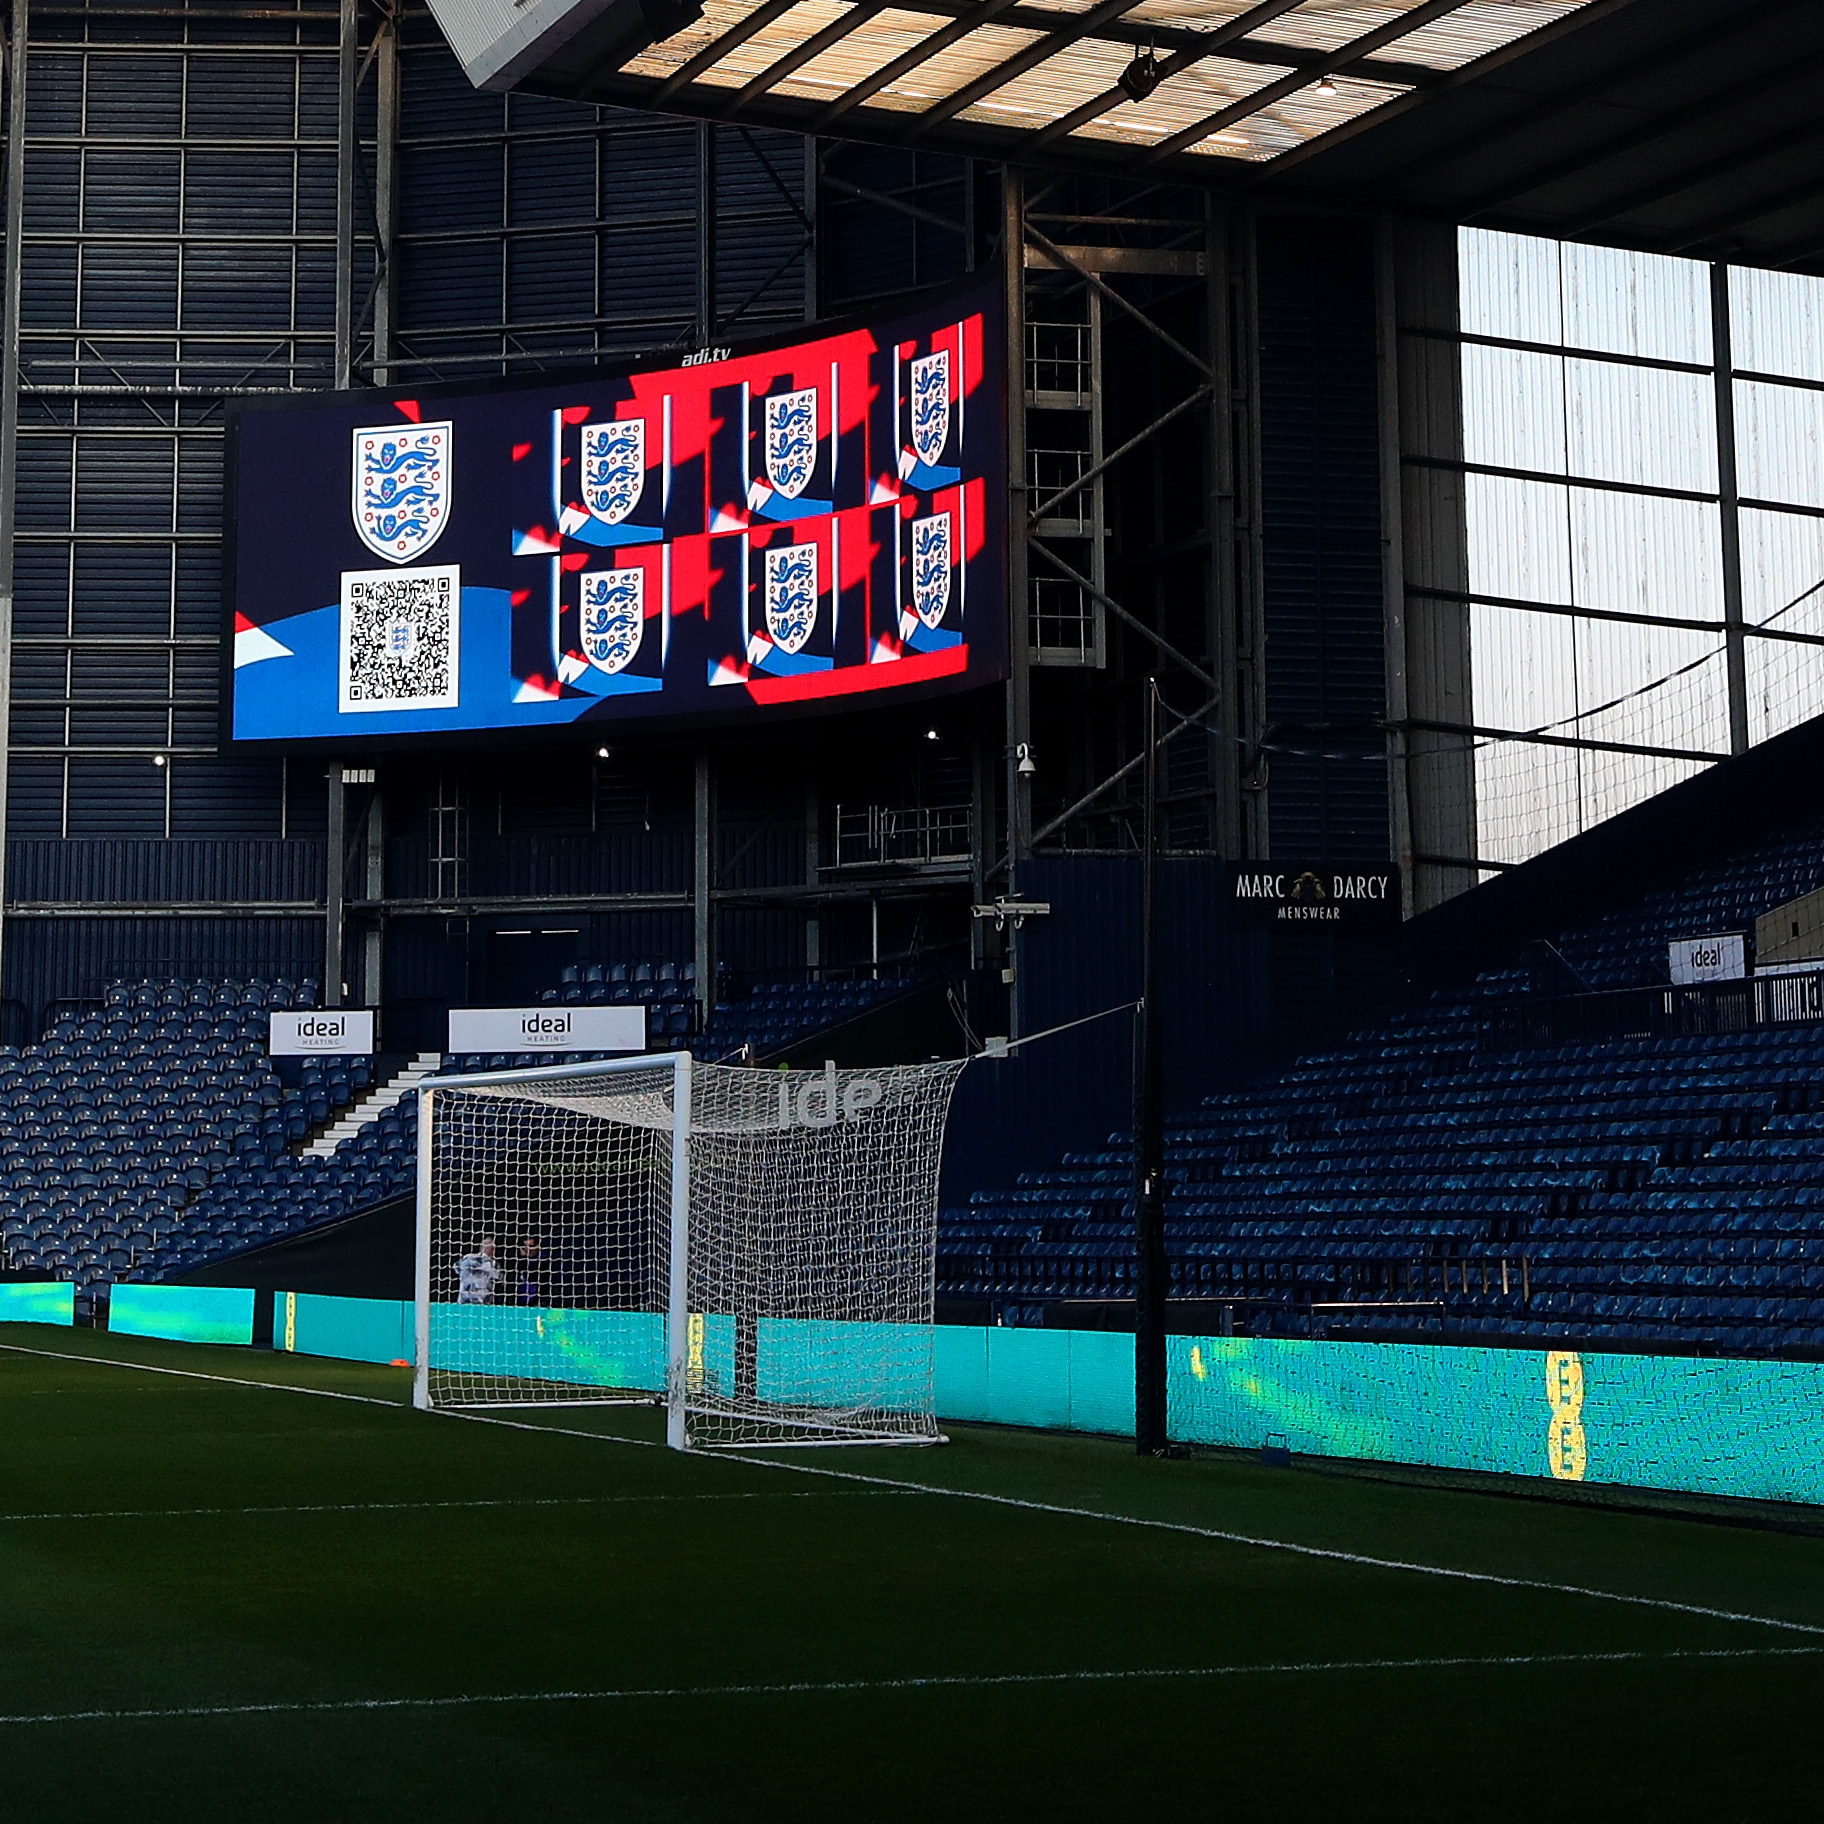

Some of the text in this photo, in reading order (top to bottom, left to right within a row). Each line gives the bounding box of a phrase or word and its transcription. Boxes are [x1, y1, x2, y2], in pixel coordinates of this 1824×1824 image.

[681, 347, 731, 367] adi.tv
[1236, 875, 1389, 899] MARC DARCY
[1277, 906, 1341, 920] MENSWEAR
[1691, 942, 1721, 968] ideal
[297, 1016, 345, 1037] ideal
[521, 1012, 571, 1033] ideal
